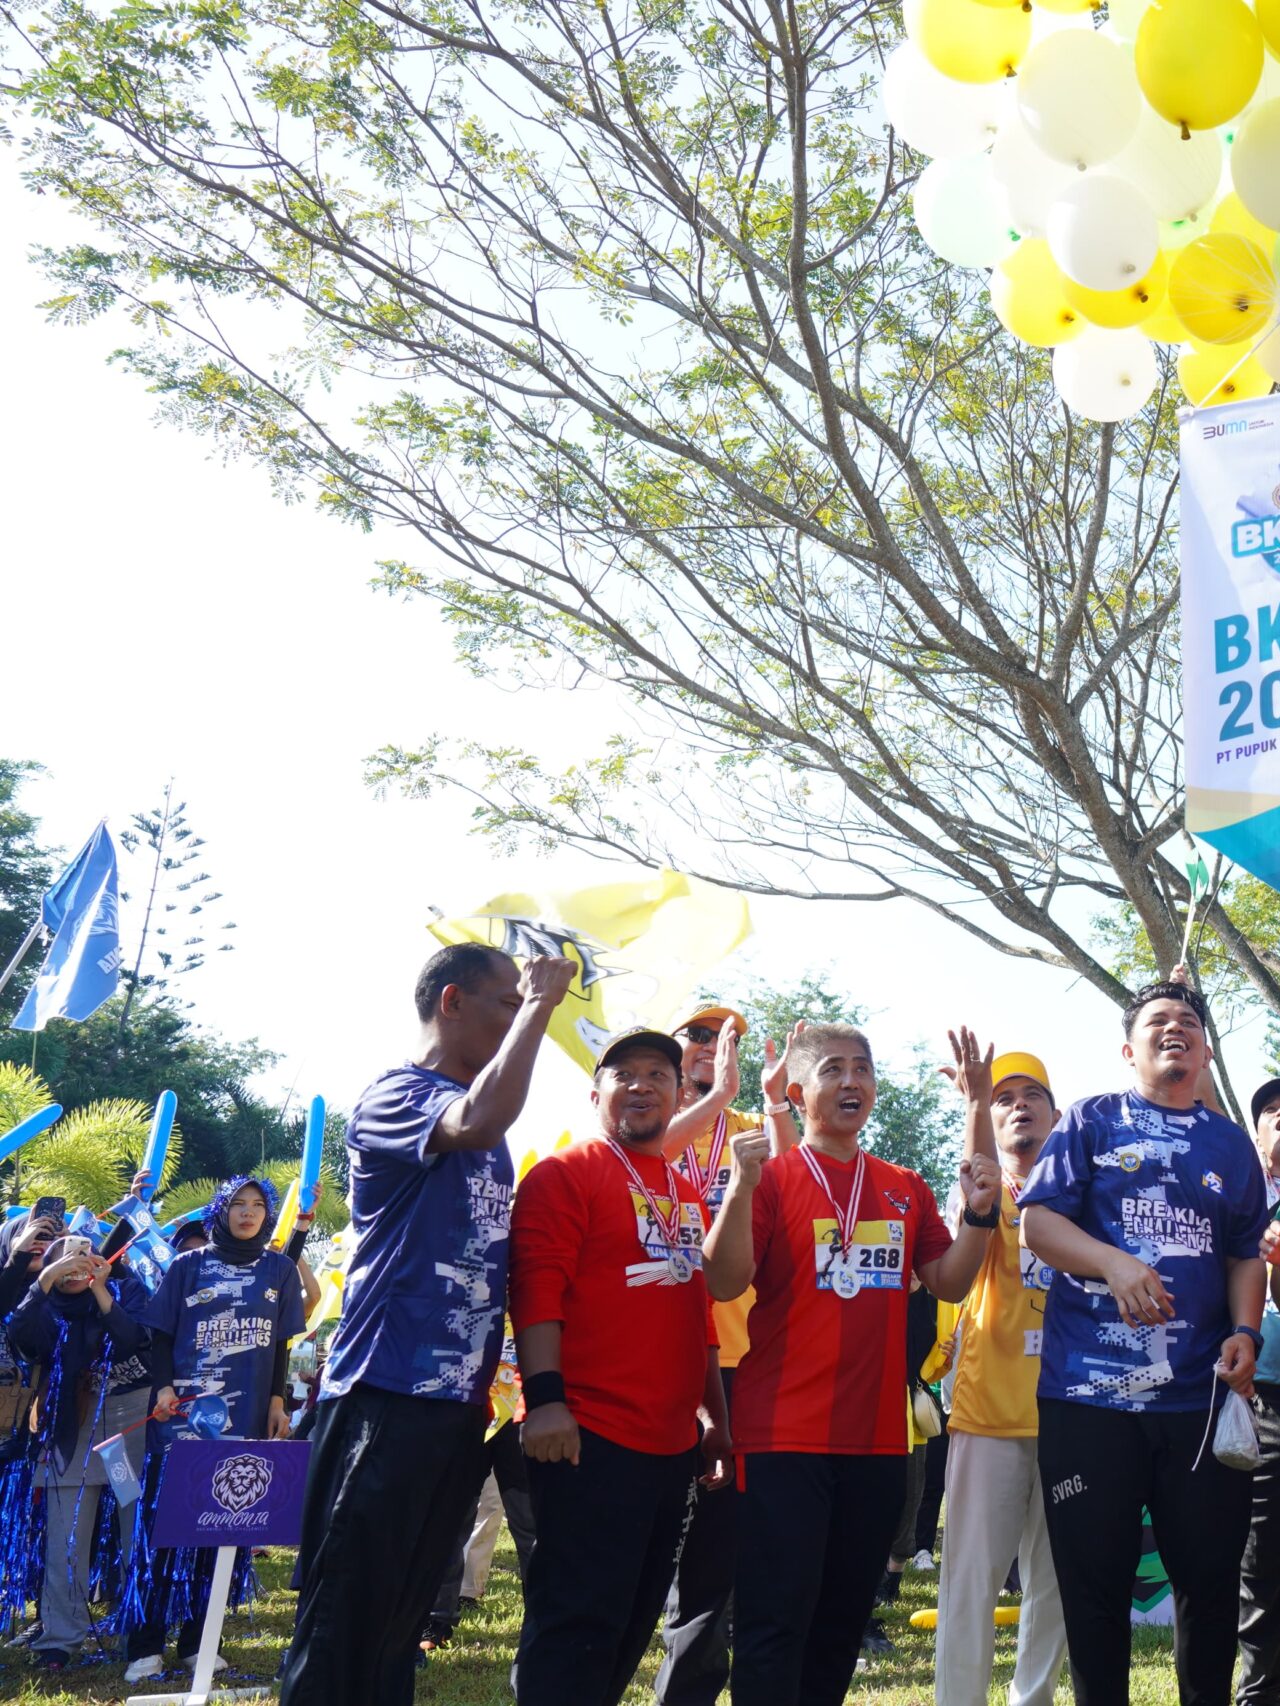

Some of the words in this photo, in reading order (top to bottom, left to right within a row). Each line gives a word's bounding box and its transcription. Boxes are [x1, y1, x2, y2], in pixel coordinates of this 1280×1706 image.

[1216, 750, 1232, 764] PT
[1235, 738, 1277, 760] PUPUK
[859, 1248, 900, 1269] 268
[197, 1317, 272, 1333] BREAKING
[1052, 1474, 1088, 1504] SVRG.
